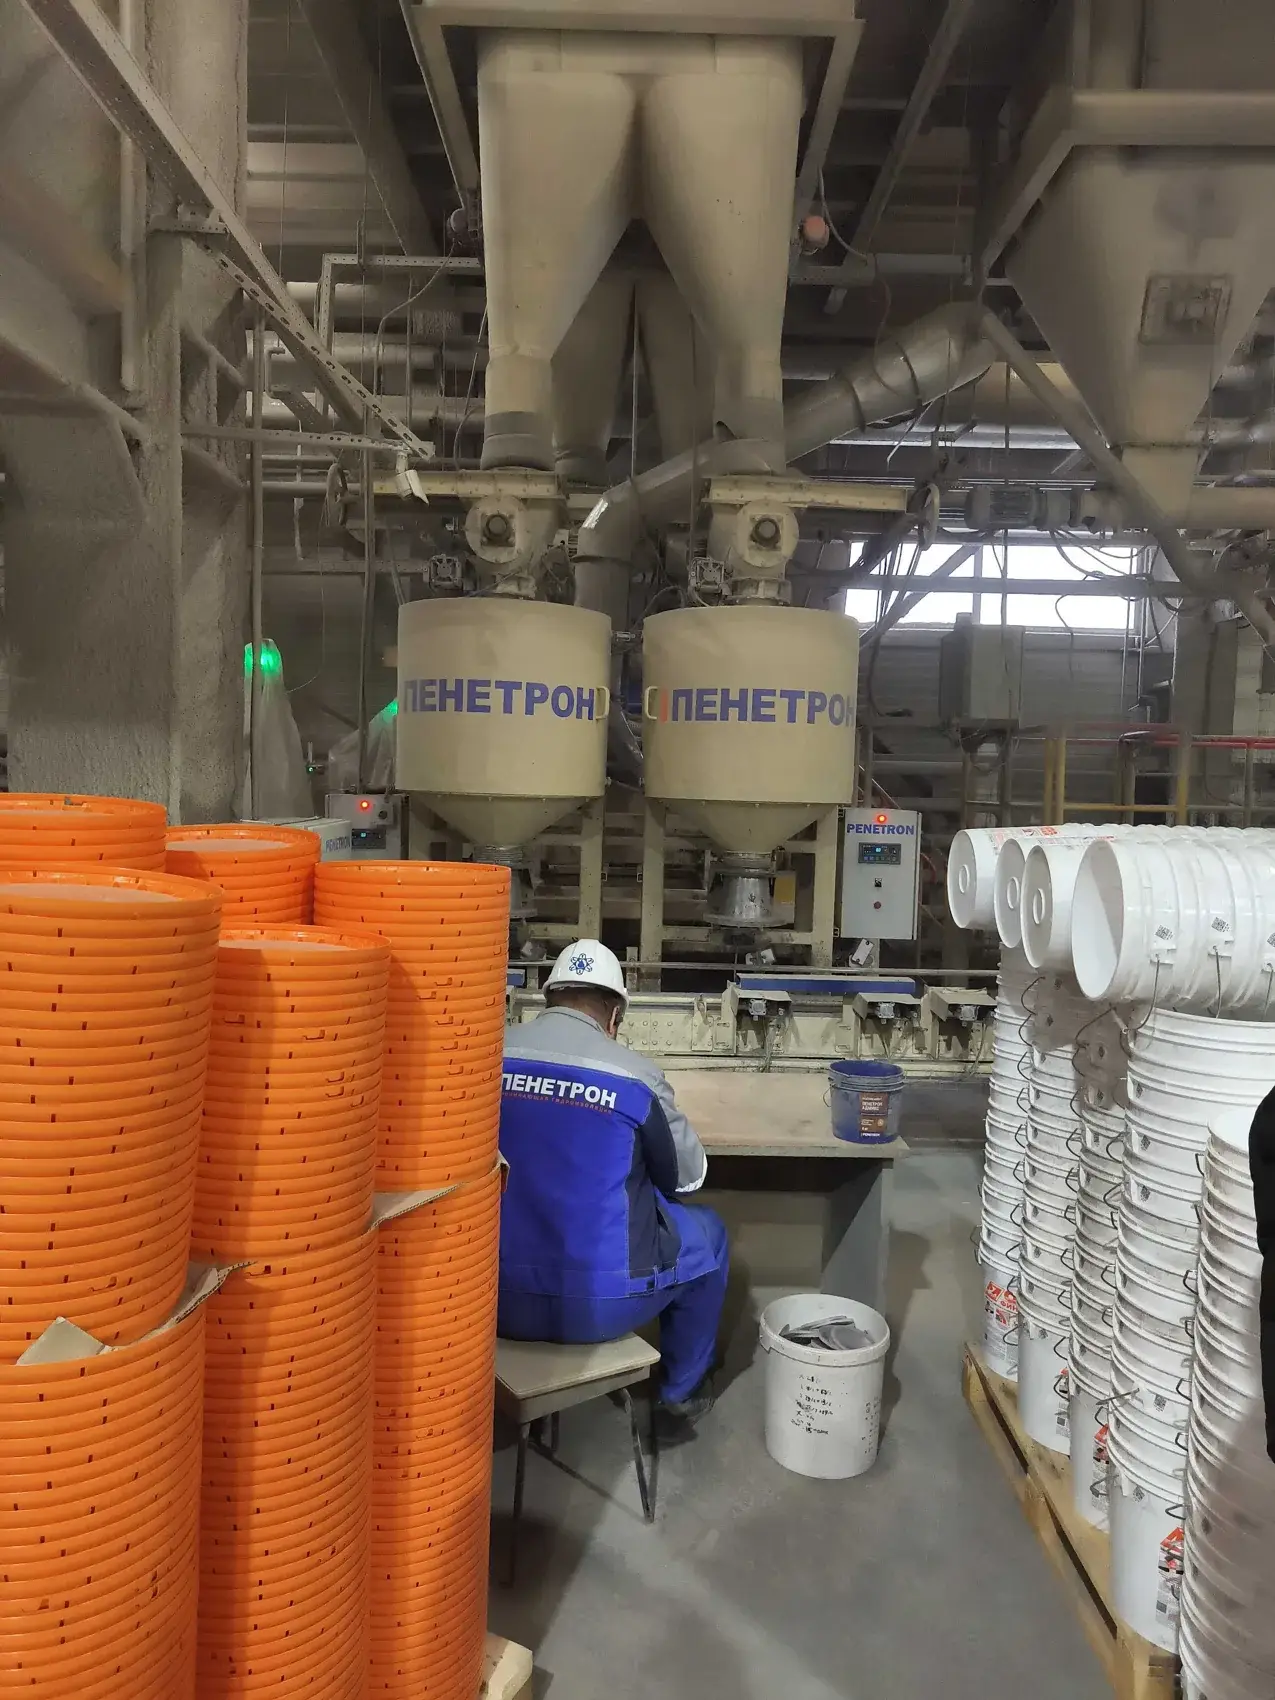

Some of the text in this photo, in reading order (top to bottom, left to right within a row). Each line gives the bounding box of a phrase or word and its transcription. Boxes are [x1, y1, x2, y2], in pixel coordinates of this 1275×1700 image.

[403, 677, 595, 720] ПЕНЕТРОН
[847, 823, 915, 835] PENETRON
[502, 1073, 617, 1109] ПЕНЕТРОН
